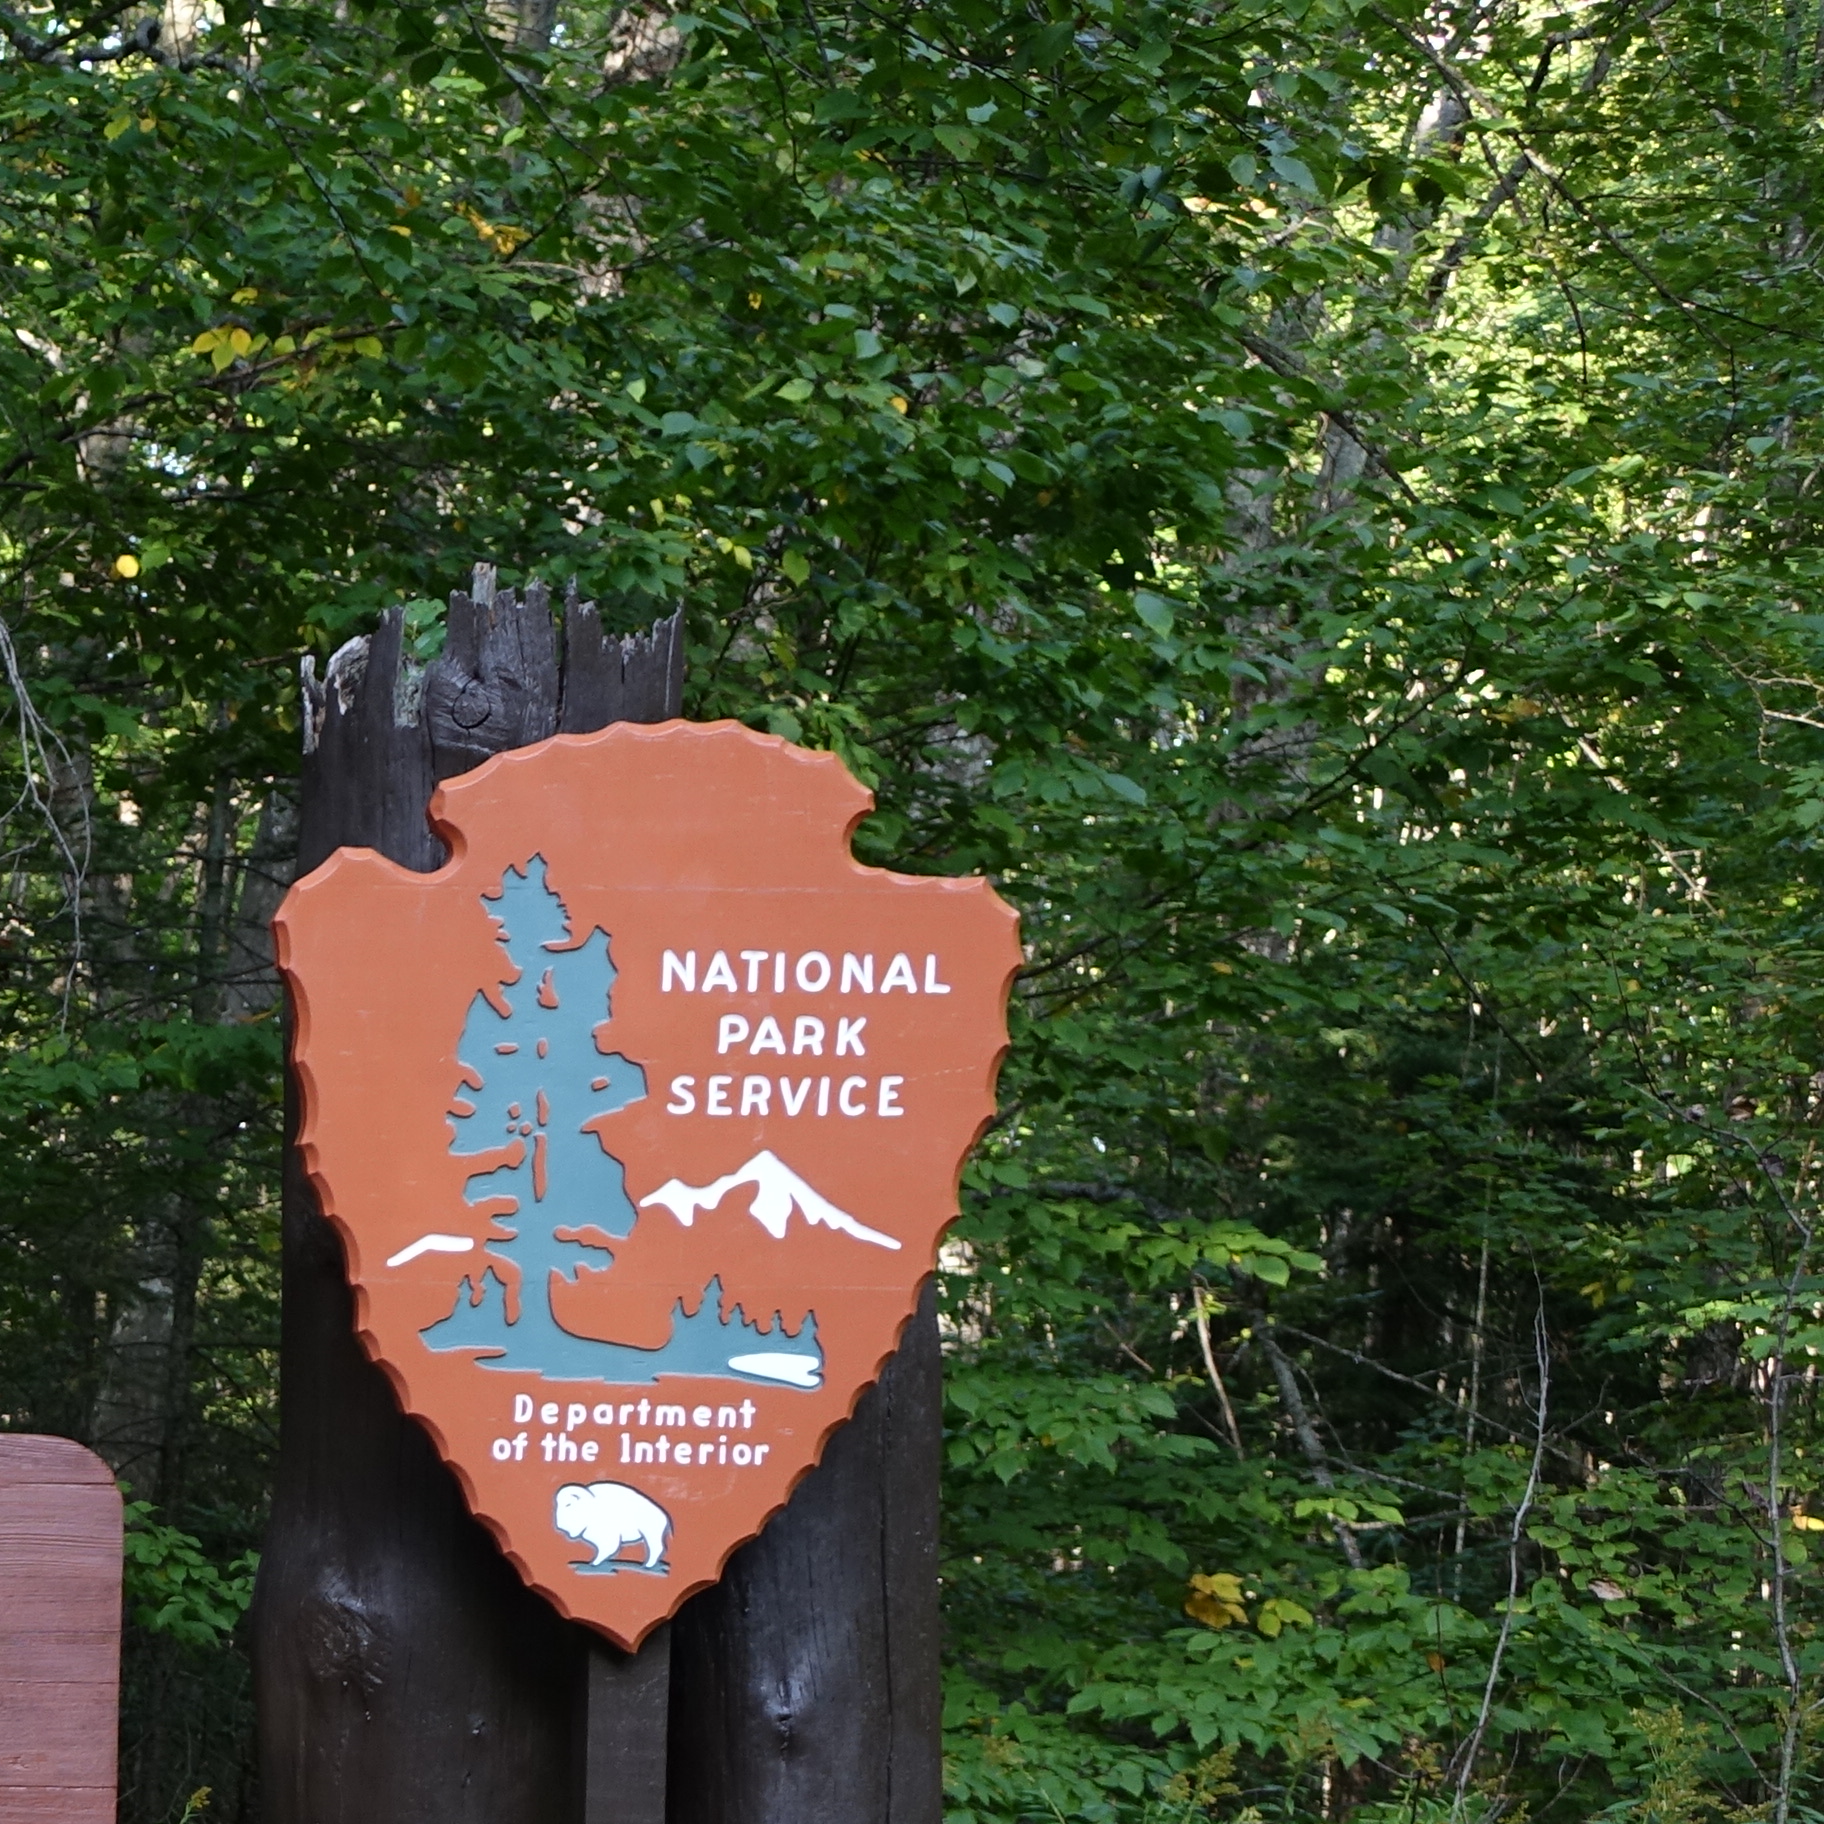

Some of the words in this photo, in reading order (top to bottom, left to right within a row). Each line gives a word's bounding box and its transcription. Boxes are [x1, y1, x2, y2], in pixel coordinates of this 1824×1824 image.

[661, 949, 951, 994] NATIONAL
[717, 1014, 867, 1057] PARK
[666, 1075, 905, 1117] SERVICE
[513, 1393, 757, 1432] Department
[492, 1433, 529, 1461] of
[540, 1432, 600, 1462] the
[619, 1432, 770, 1466] Interior
